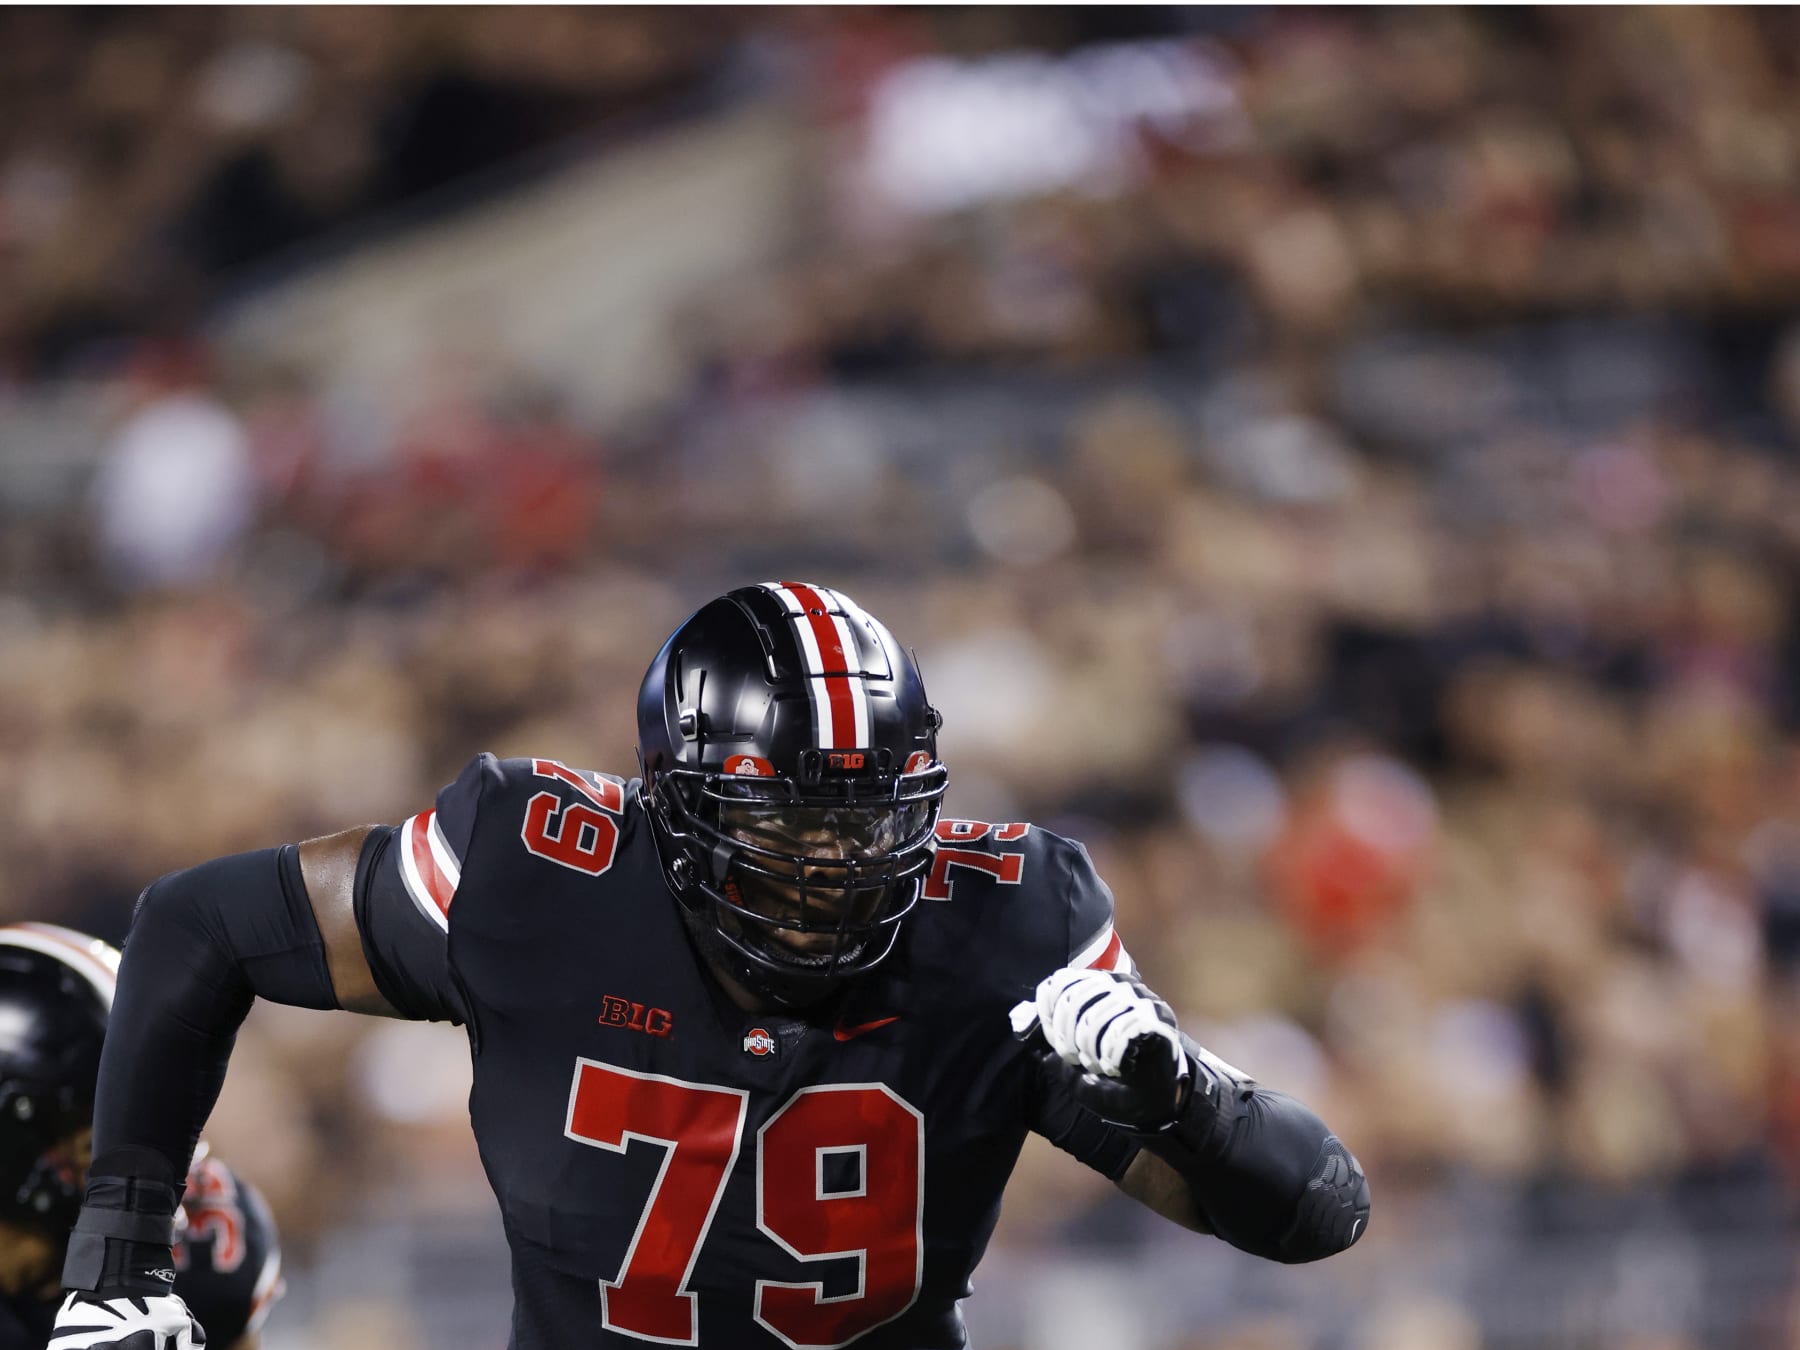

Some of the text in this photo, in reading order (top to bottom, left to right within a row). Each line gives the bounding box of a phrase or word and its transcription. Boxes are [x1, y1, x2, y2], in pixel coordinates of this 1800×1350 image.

[521, 758, 624, 877] 79
[598, 994, 673, 1038] BIG
[564, 1056, 925, 1350] 79
